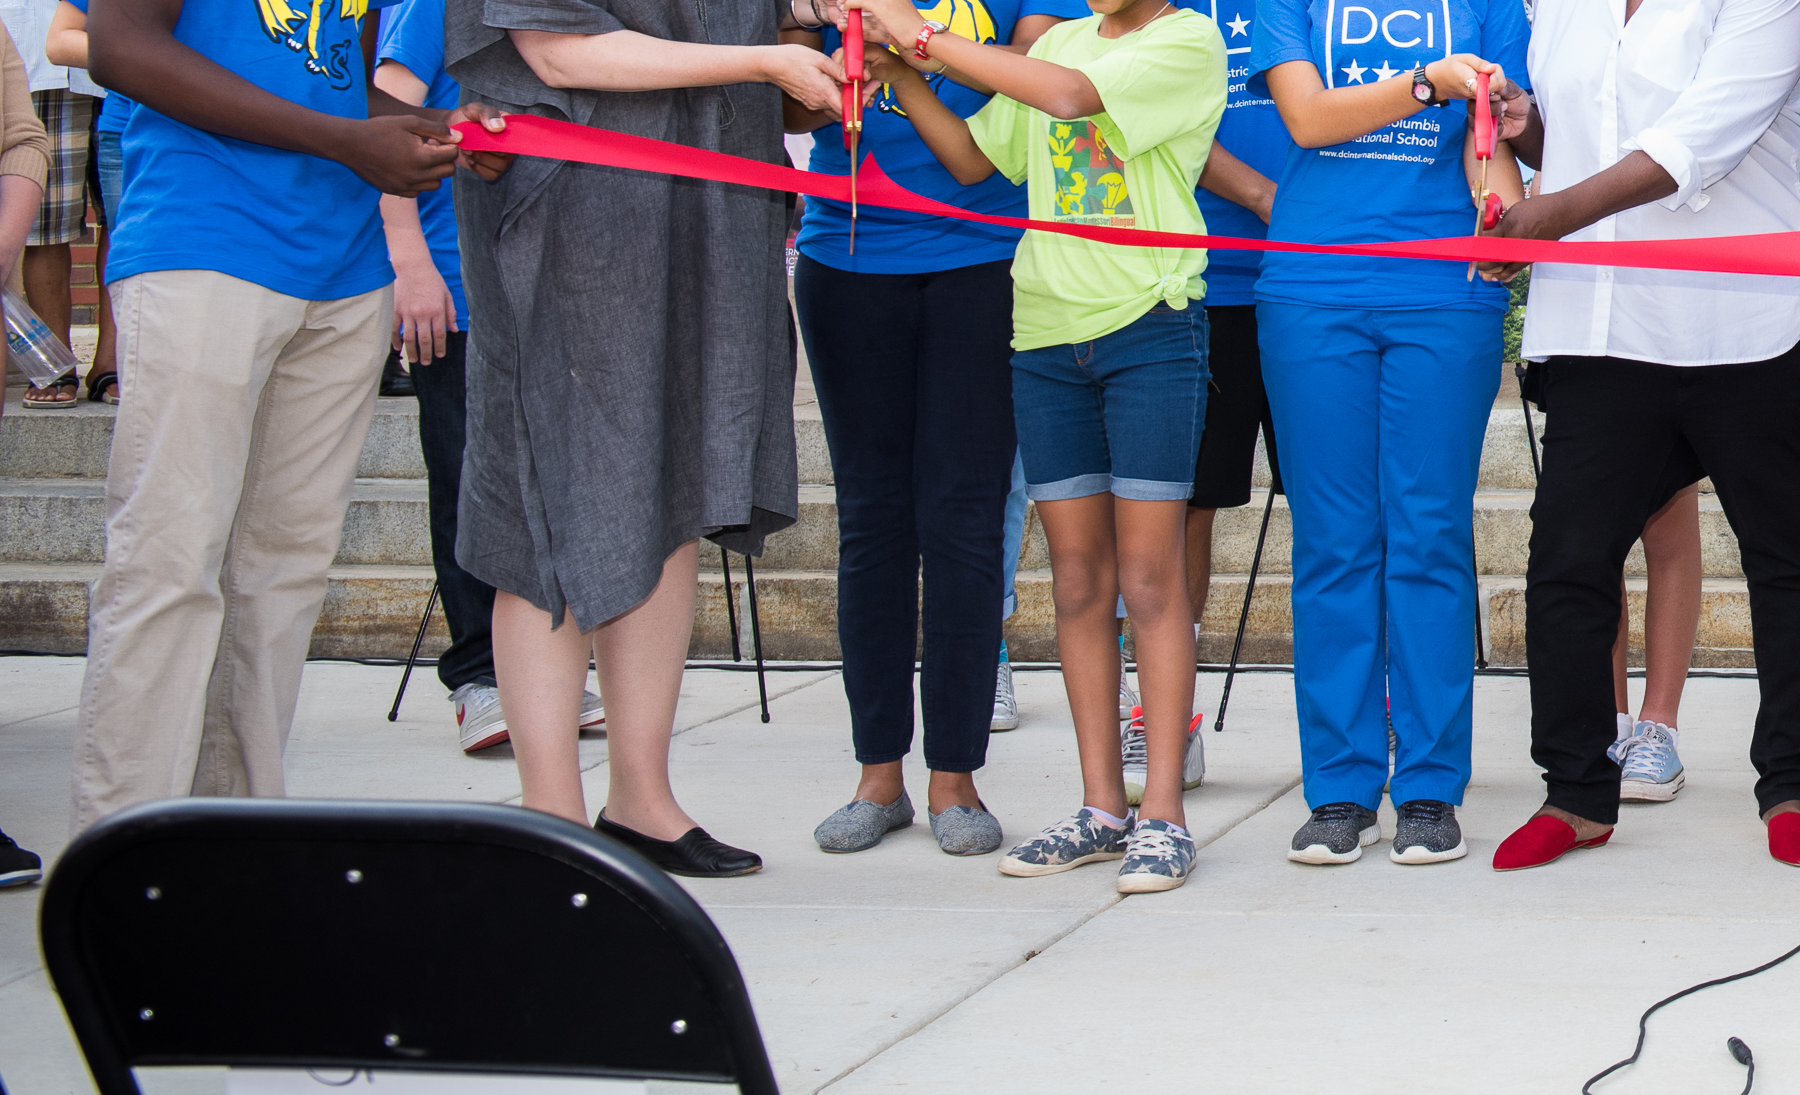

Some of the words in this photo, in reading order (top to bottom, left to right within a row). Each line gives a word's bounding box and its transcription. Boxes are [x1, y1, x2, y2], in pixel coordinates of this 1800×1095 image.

[1342, 7, 1433, 48] DCI
[1387, 119, 1440, 132] olumbia
[1397, 133, 1437, 147] School
